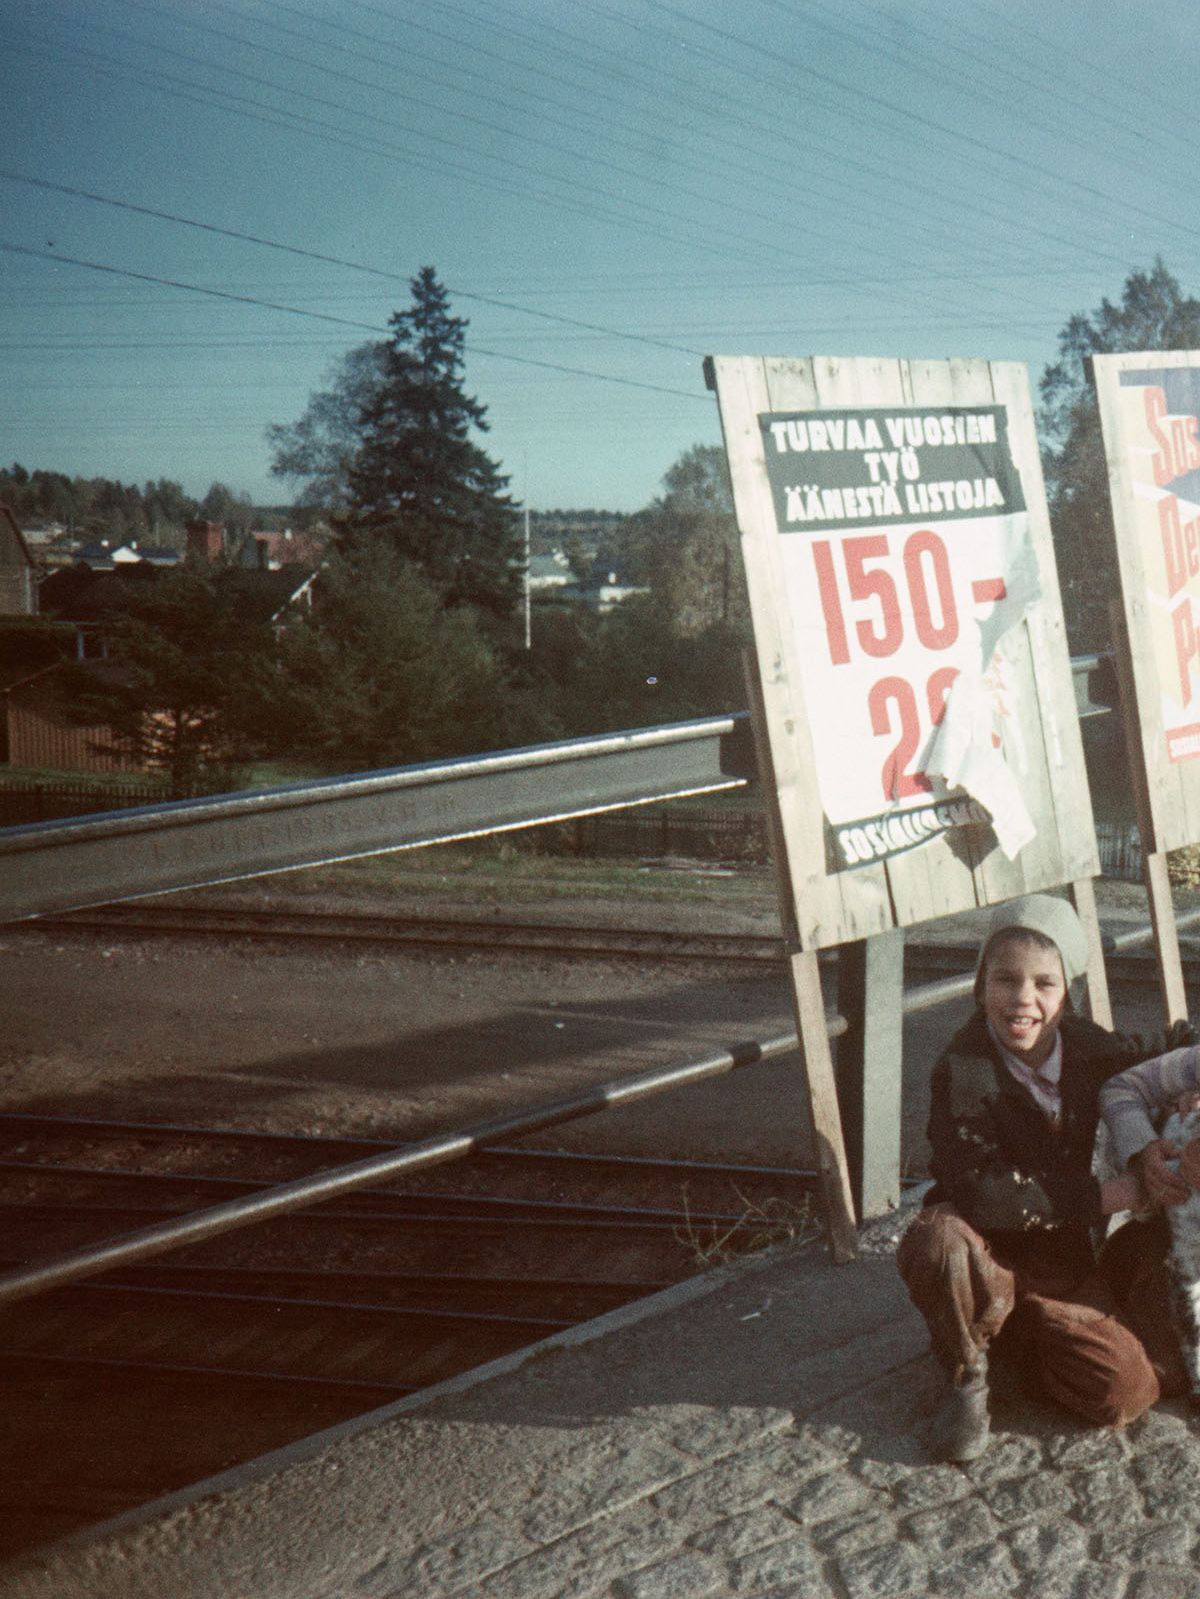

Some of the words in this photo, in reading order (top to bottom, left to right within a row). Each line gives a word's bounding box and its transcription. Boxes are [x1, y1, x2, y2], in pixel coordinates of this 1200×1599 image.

[769, 418, 885, 453] TURVAA
[884, 413, 998, 449] VUOSIEN
[863, 445, 921, 483] TYÖ
[783, 480, 904, 523] ÄÄNESTÄ
[904, 477, 1006, 514] LISTOJA
